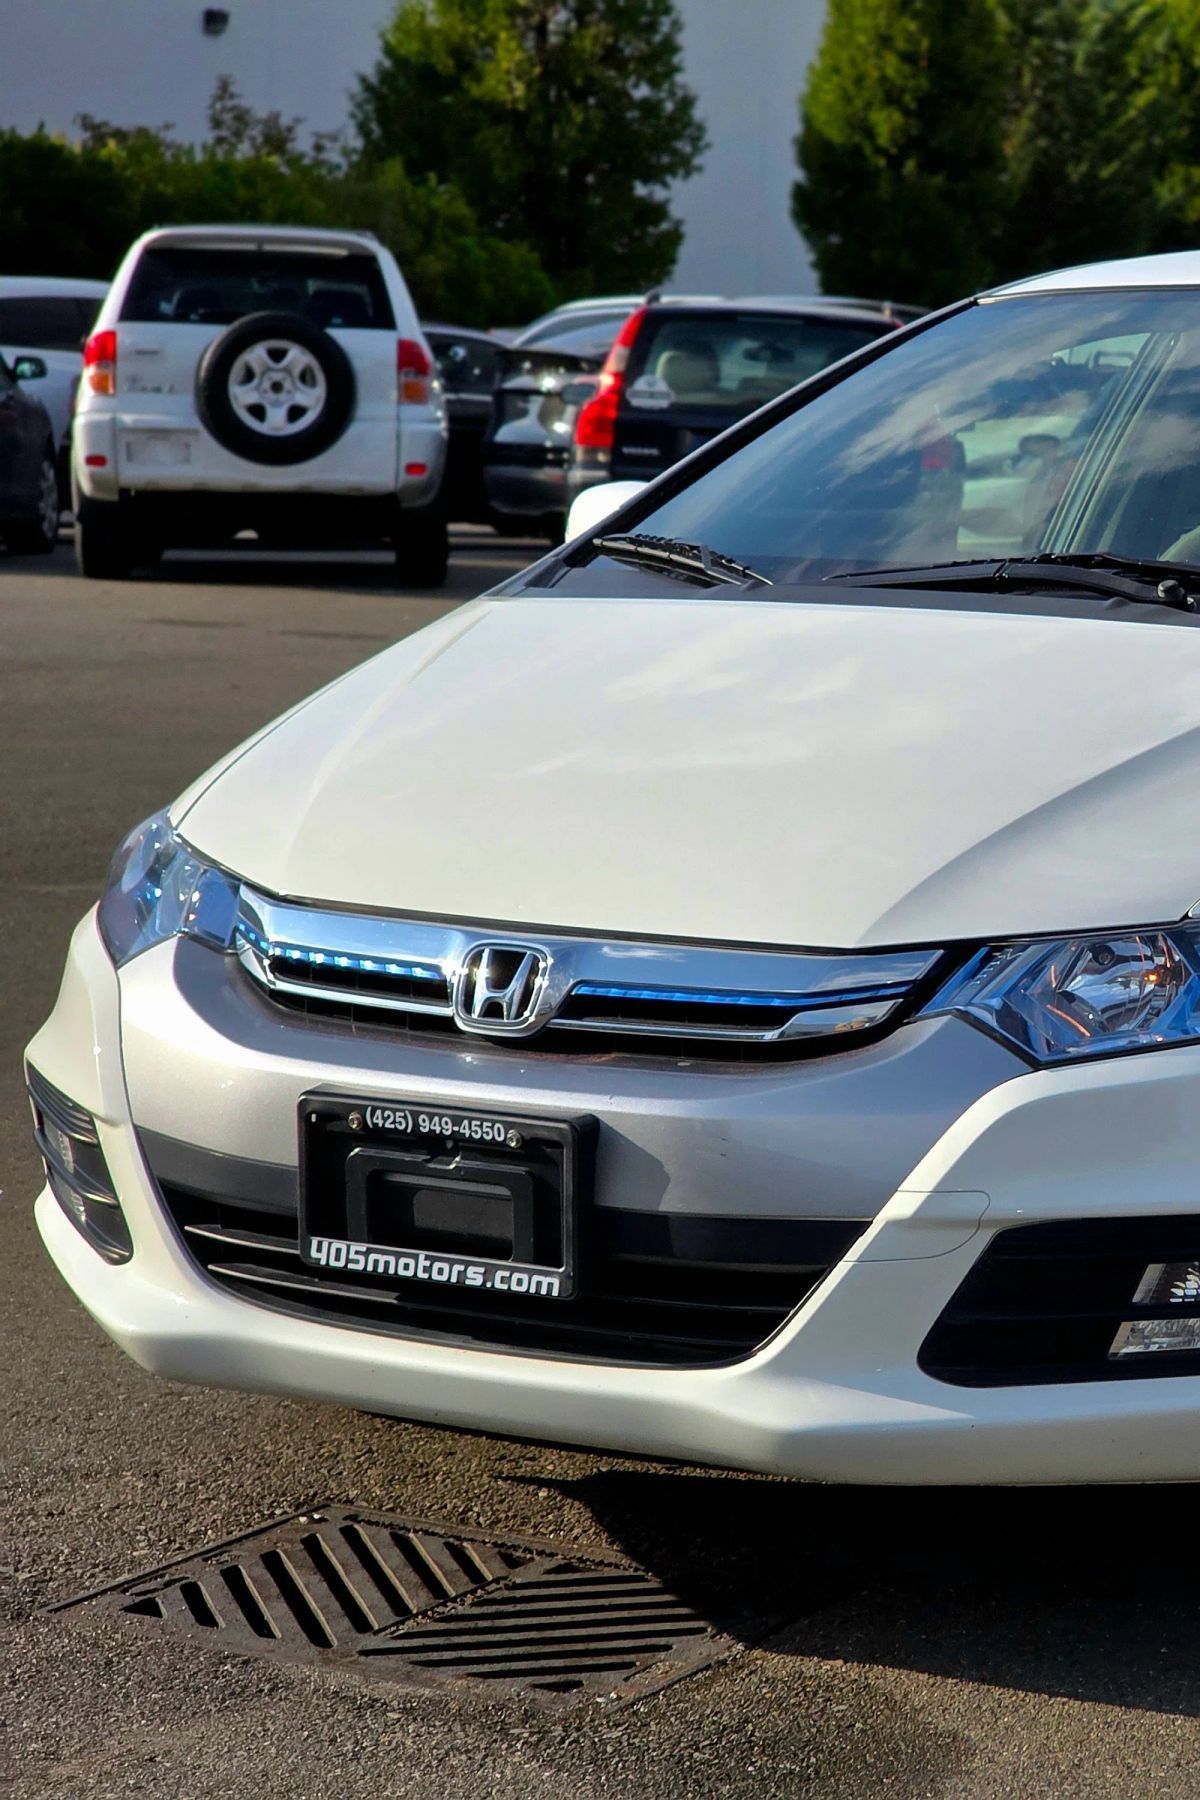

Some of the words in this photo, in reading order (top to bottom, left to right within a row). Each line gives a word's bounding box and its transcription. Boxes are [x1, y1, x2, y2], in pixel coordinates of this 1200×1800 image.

[366, 1106, 413, 1133] (425)
[418, 1115, 505, 1141] 949-4550
[310, 1239, 560, 1297] 405motors.com
